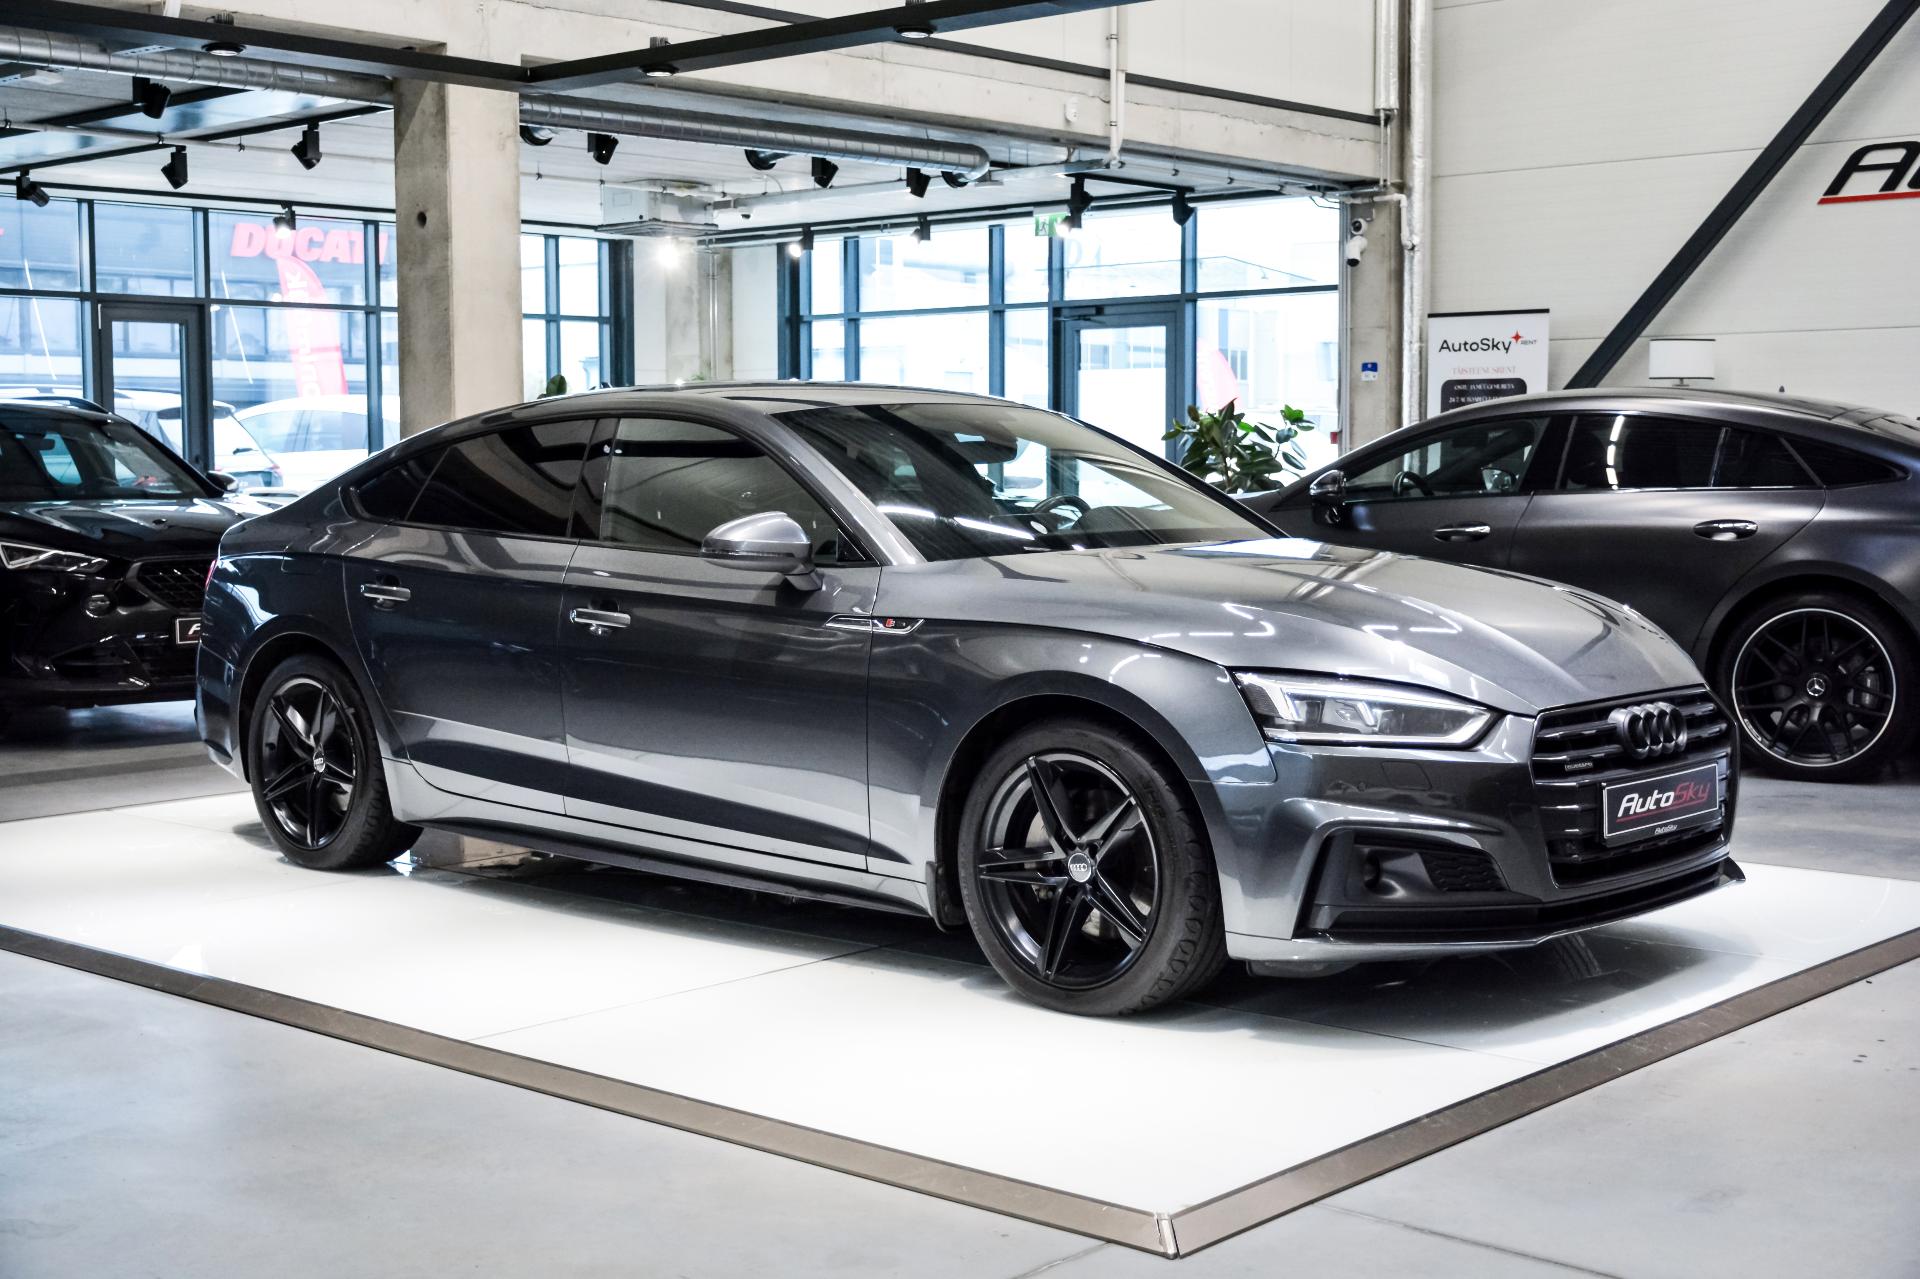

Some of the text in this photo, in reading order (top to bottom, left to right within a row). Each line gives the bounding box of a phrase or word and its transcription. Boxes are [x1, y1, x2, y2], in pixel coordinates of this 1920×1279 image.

[231, 223, 388, 264] DUCATI
[1439, 338, 1512, 354] AutoSky
[1617, 782, 1711, 817] AutoSky
